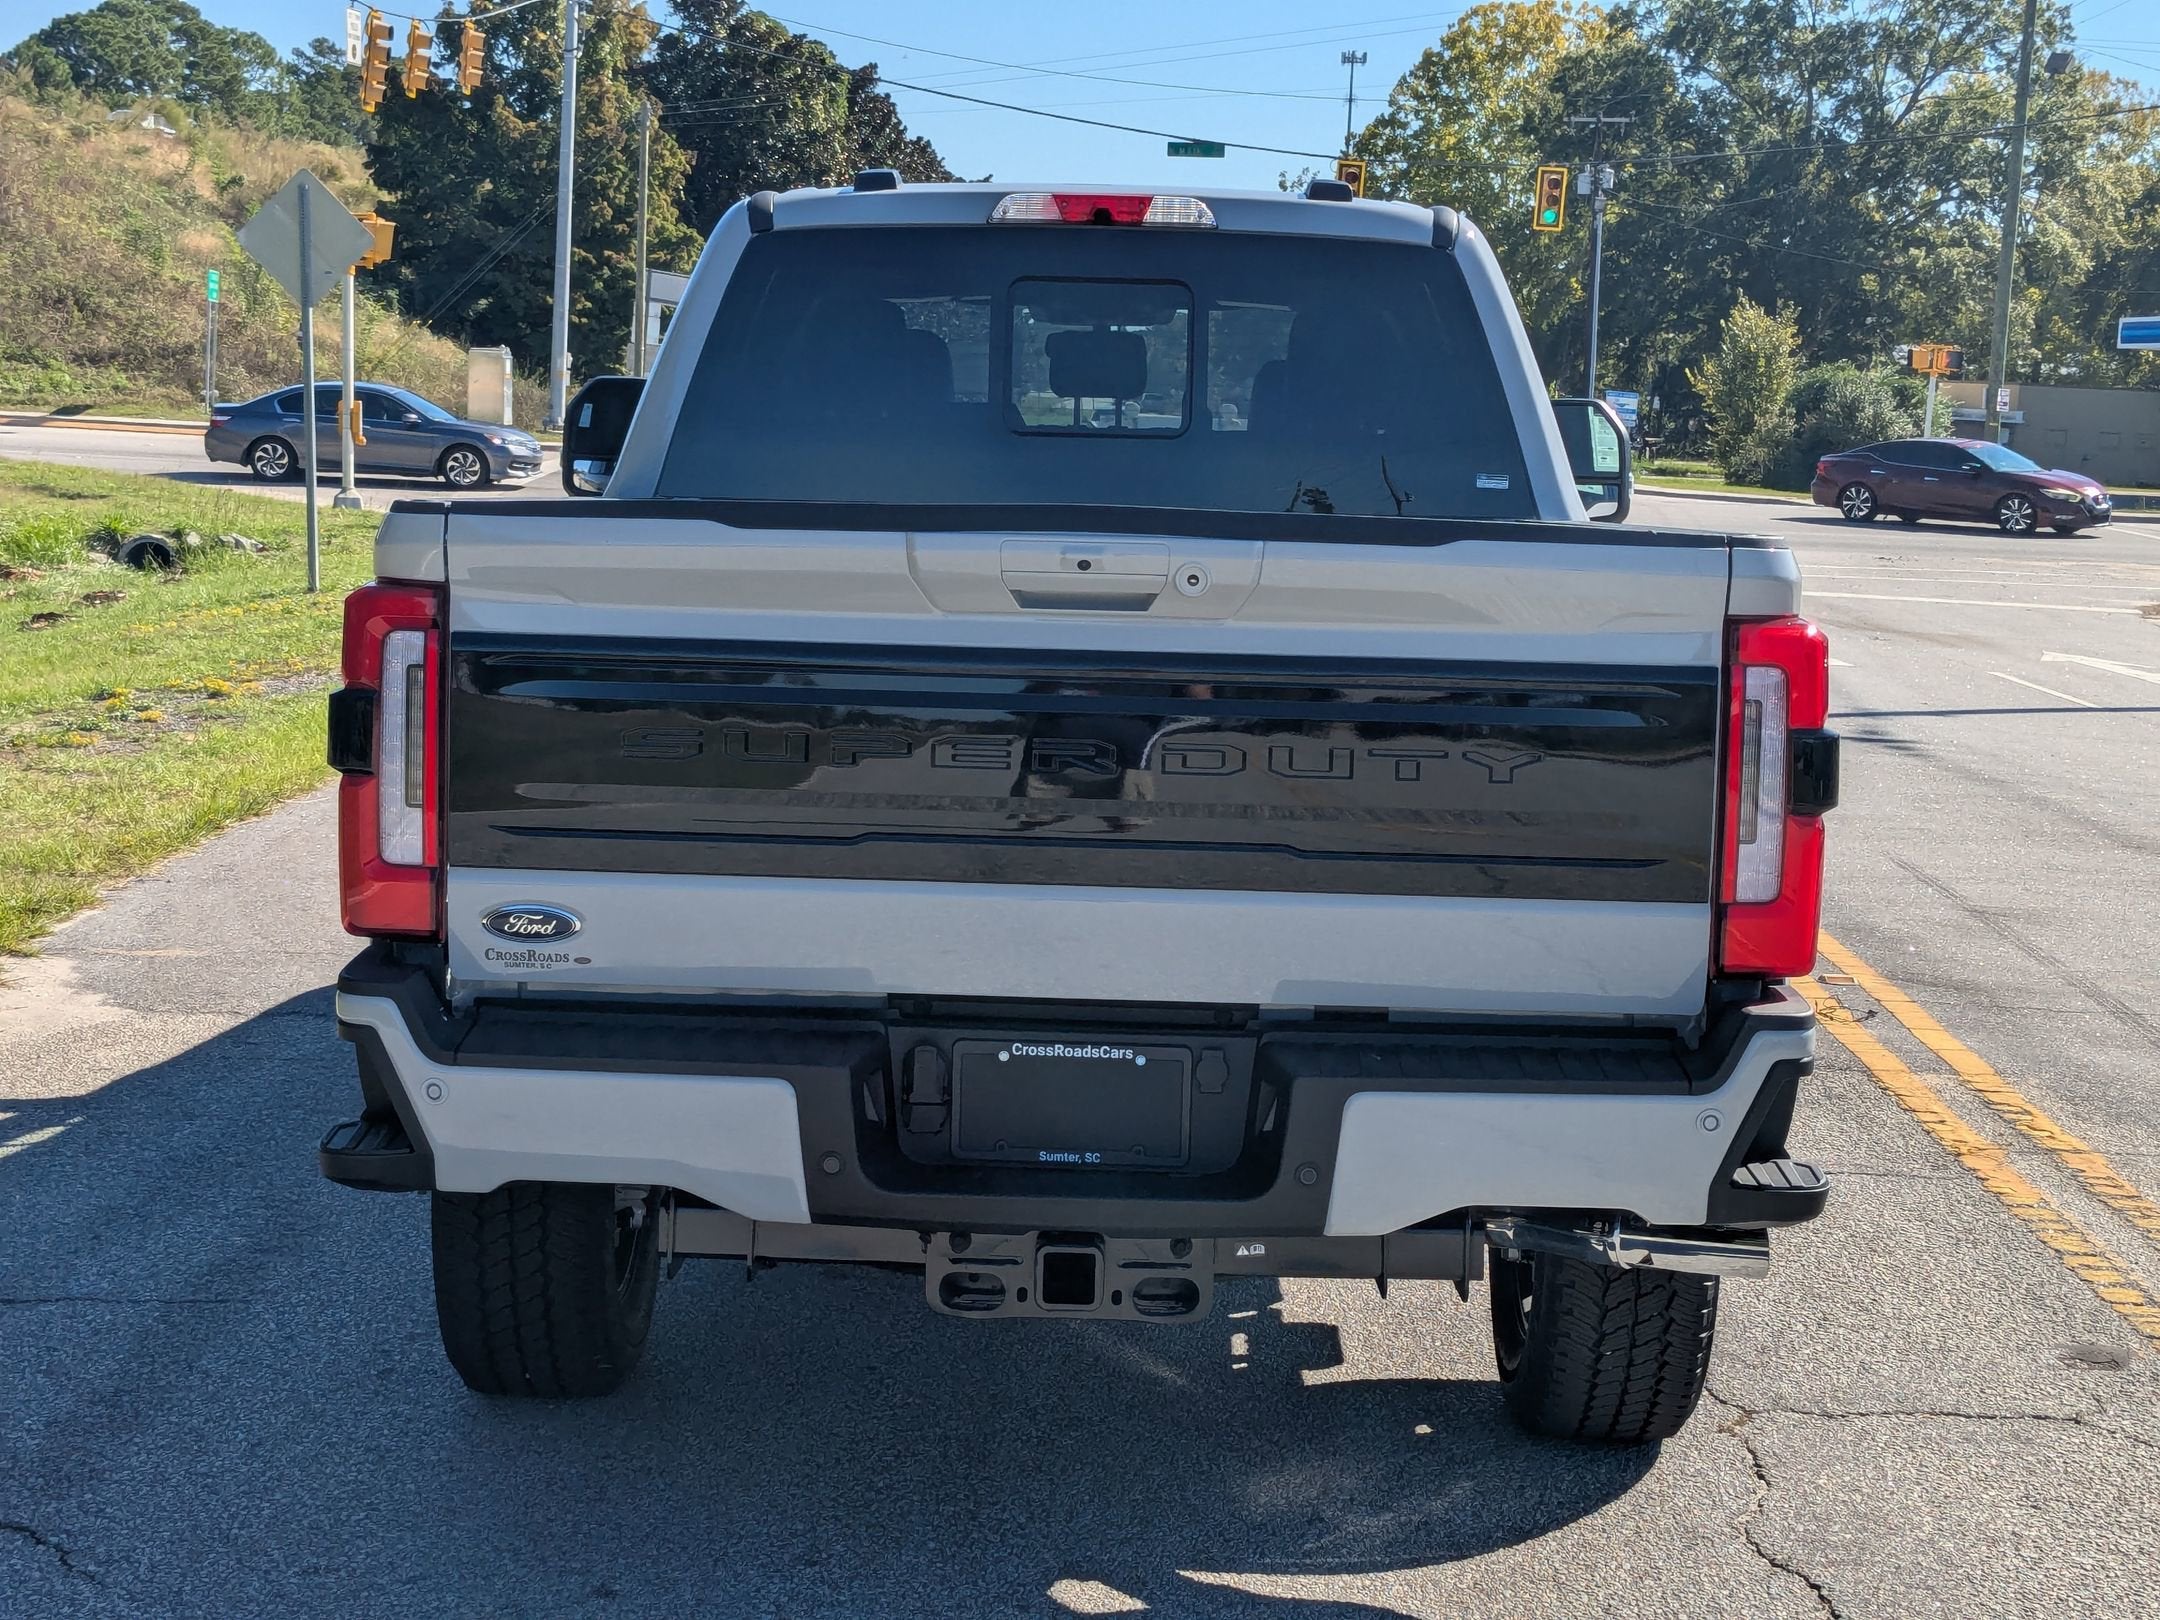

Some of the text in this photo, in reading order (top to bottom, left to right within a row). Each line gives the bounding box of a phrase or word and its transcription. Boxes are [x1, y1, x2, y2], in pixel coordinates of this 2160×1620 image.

[621, 725, 1544, 785] SUPER DUTY
[504, 913, 557, 935] Ford
[1012, 1042, 1134, 1060] CrossRoadsCars
[1039, 1151, 1101, 1164] Sumter, SC
